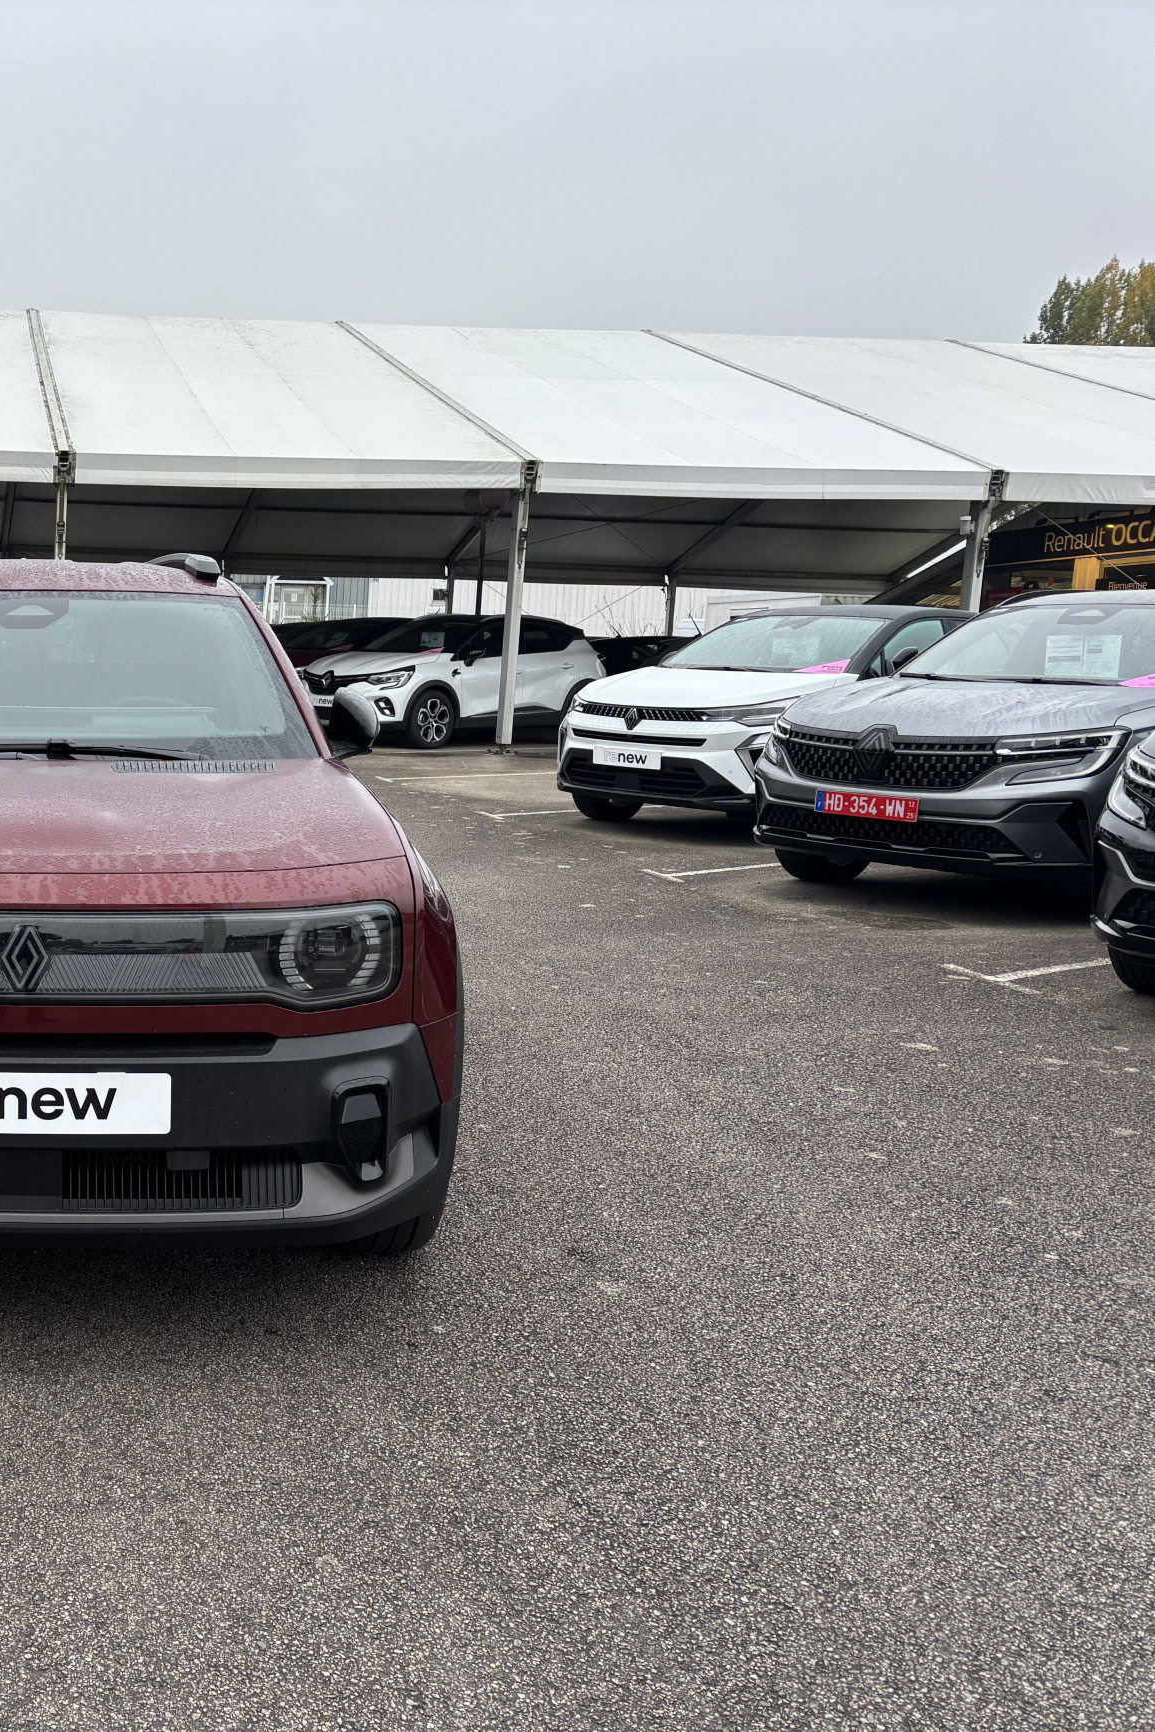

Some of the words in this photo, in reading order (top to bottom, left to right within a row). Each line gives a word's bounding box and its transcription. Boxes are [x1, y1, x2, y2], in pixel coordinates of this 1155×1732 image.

[1044, 525, 1106, 553] Renault
[1108, 581, 1148, 590] Bienvenue
[604, 750, 647, 765] renew
[825, 793, 906, 818] HD-354-WN
